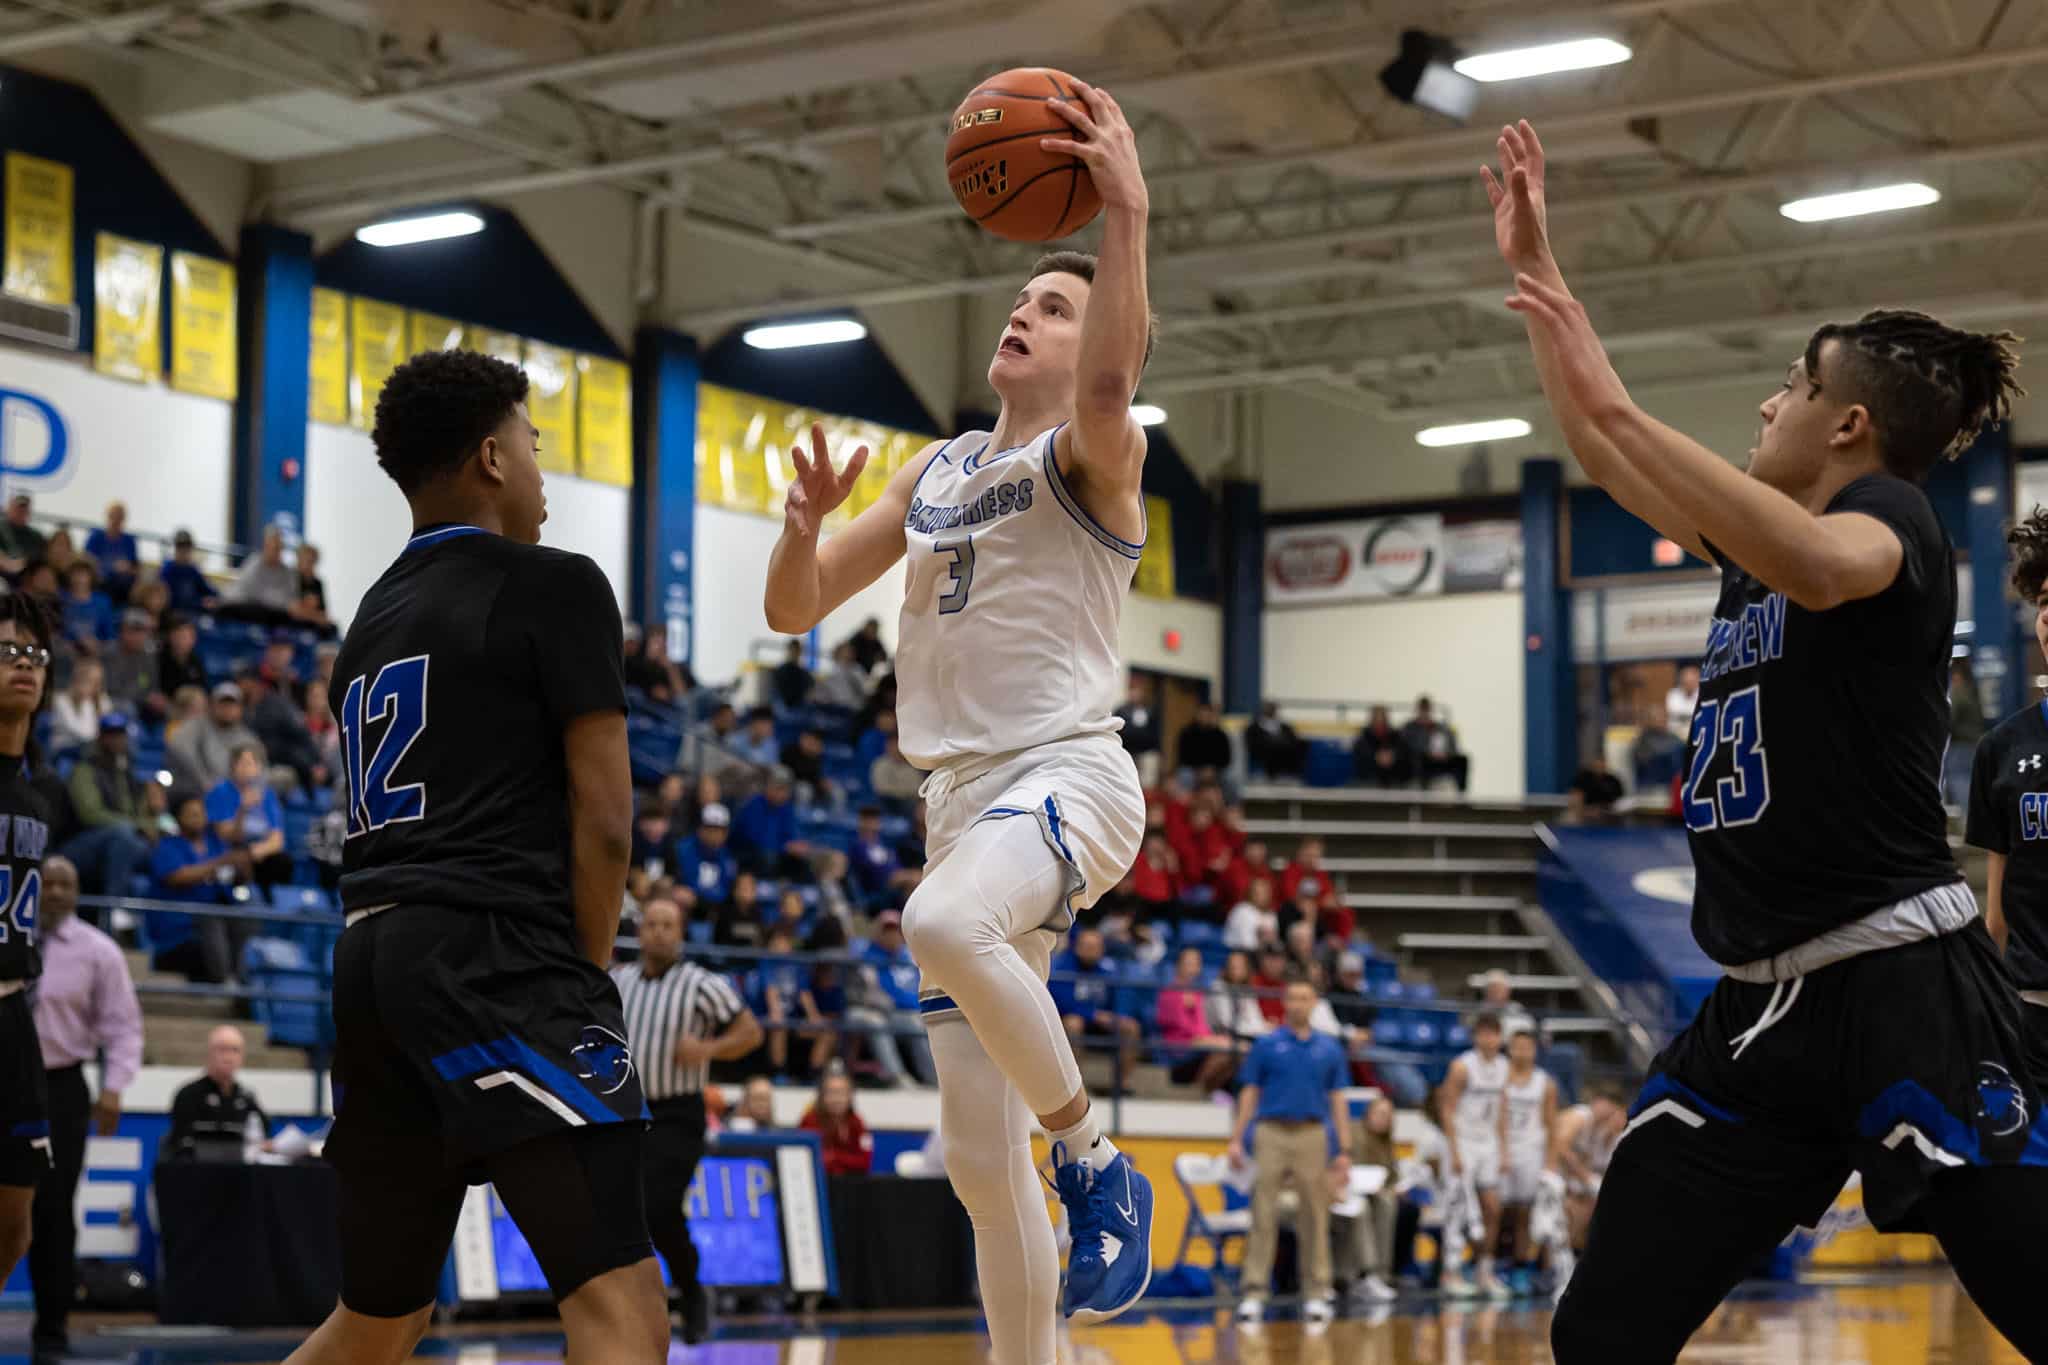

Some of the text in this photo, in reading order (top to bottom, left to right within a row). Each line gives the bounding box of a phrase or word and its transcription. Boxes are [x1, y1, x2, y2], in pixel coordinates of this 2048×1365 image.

[933, 535, 976, 616] 3
[341, 653, 430, 841] 12
[1680, 685, 1771, 832] 23
